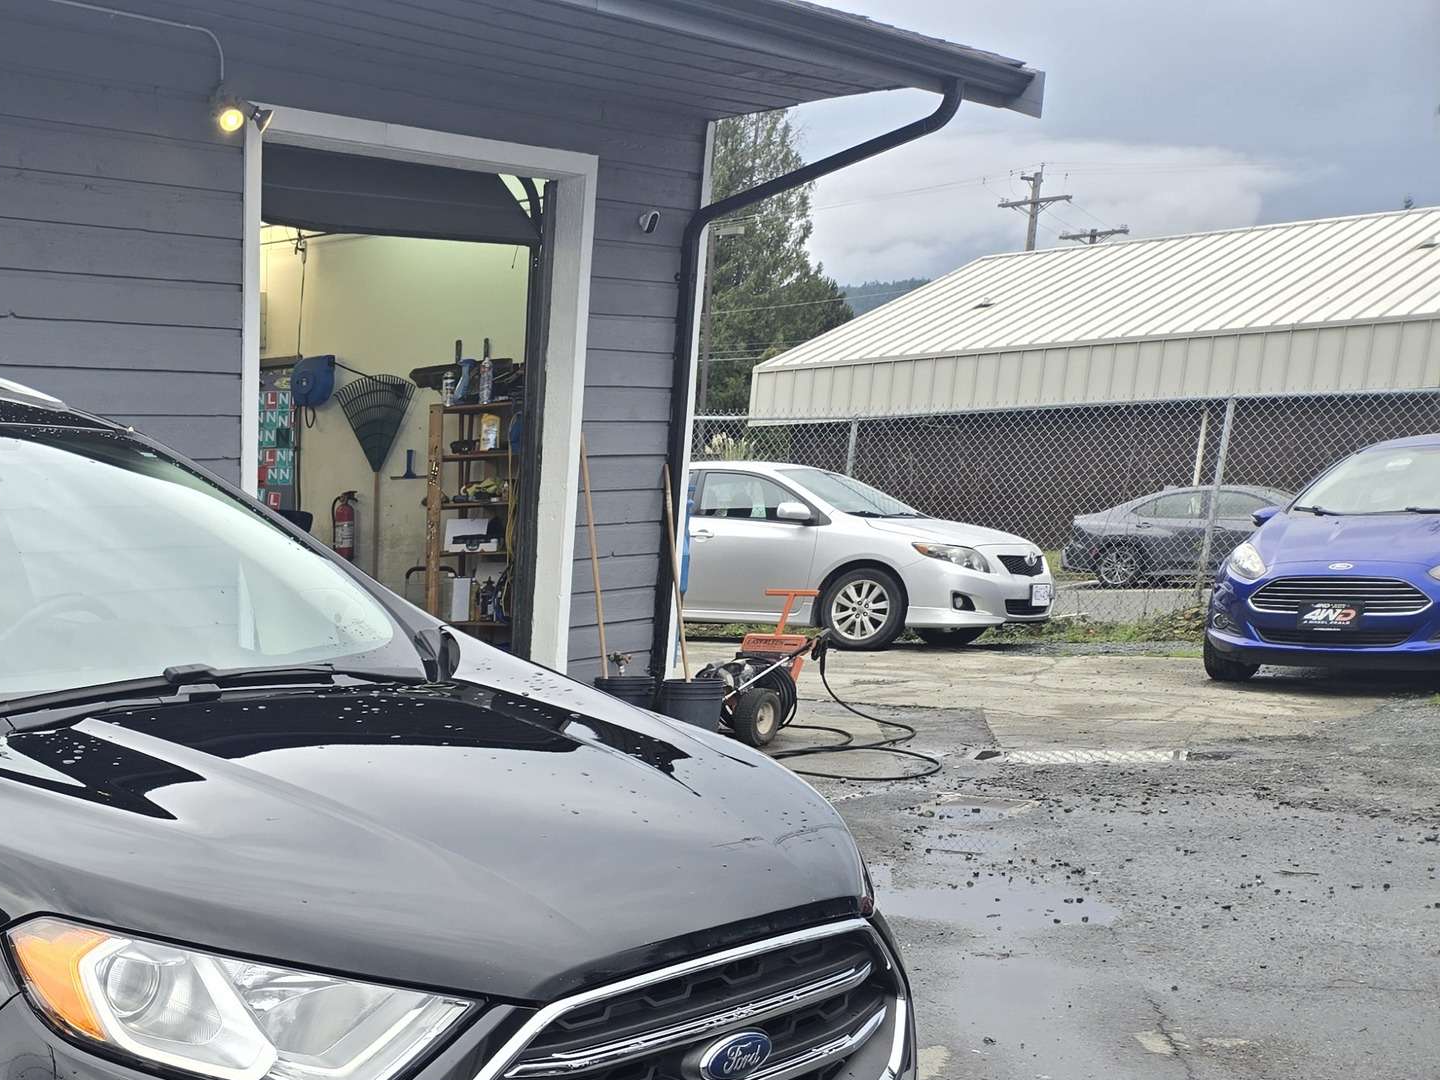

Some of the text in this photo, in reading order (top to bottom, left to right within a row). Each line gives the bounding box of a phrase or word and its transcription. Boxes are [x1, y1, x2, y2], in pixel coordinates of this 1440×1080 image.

[279, 392, 289, 404] N
[266, 411, 276, 423] N
[278, 415, 288, 427] N
[265, 430, 275, 441] N
[276, 450, 286, 461] N
[268, 468, 290, 480] N N
[1302, 607, 1356, 621] 4WD
[723, 1041, 761, 1075] Ford
